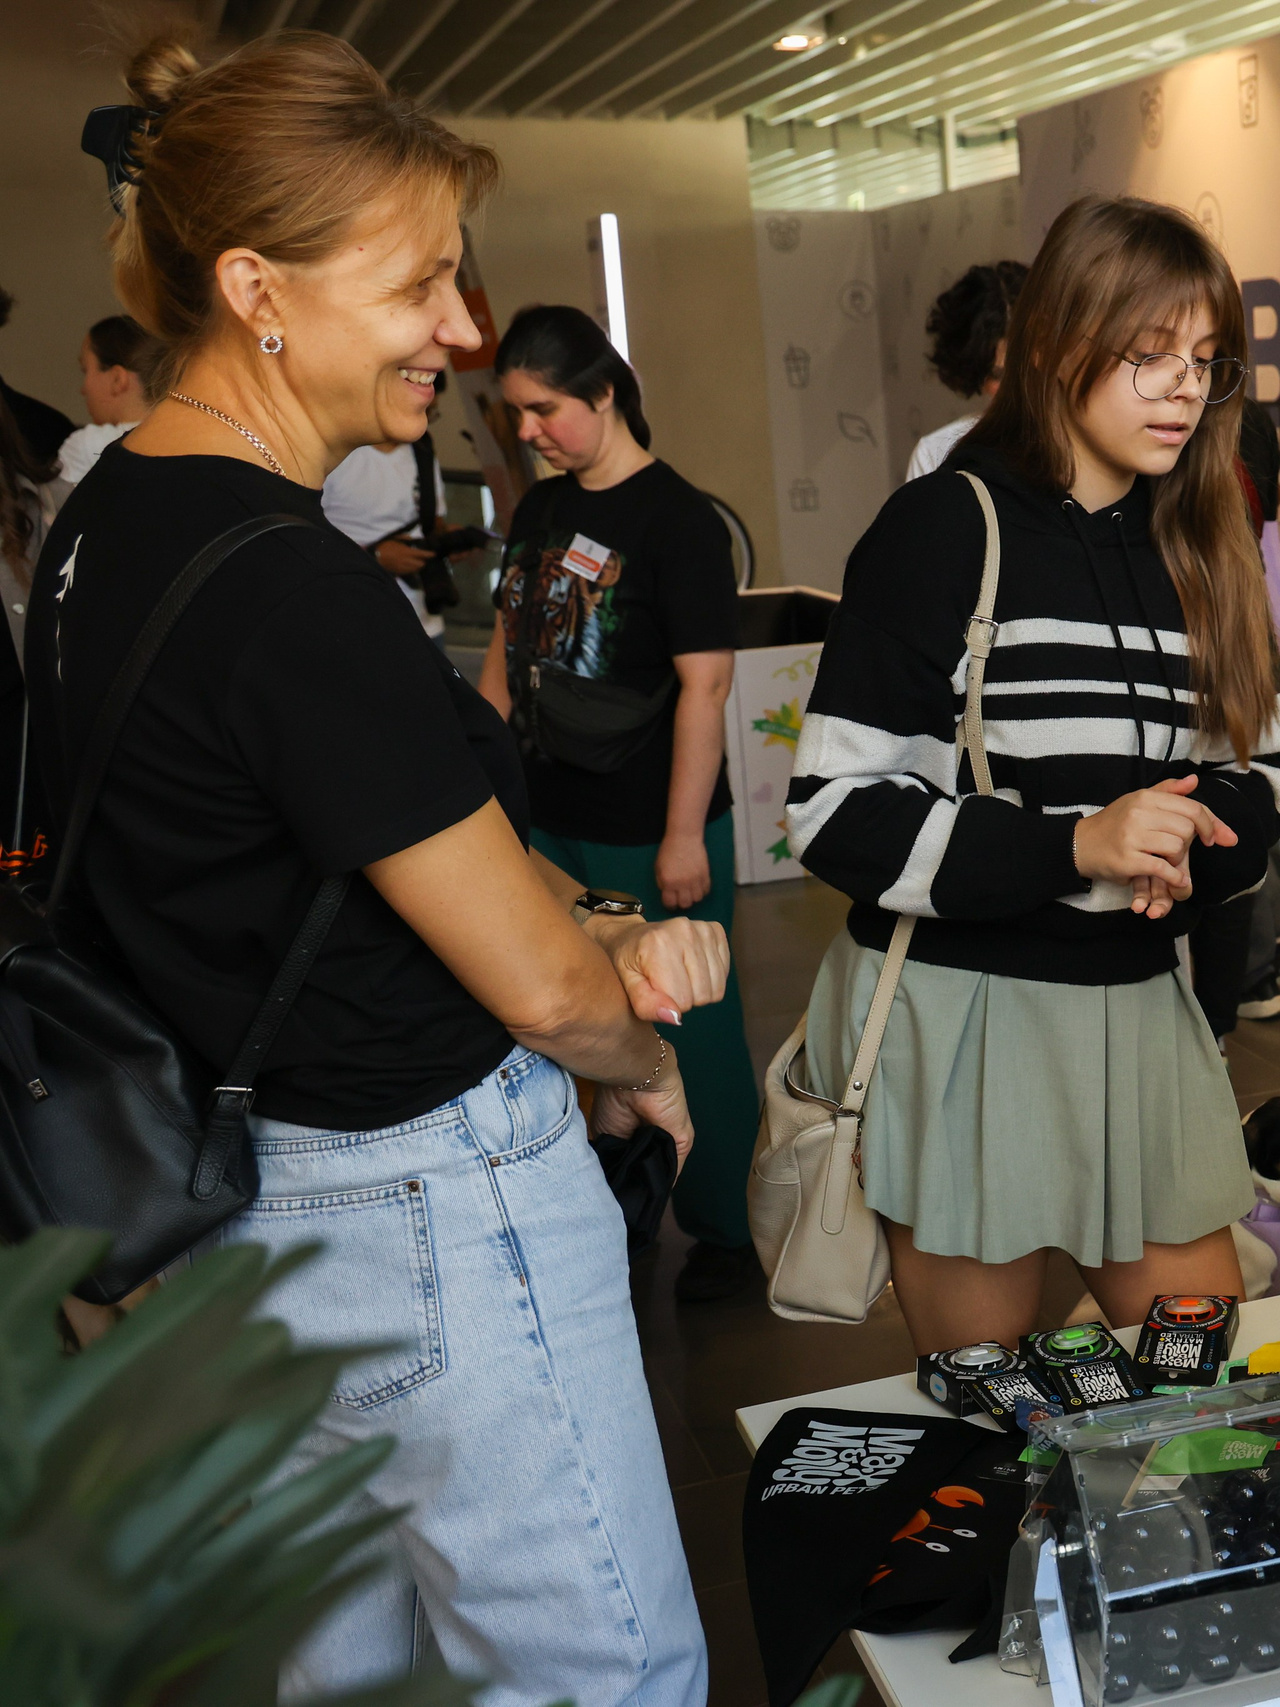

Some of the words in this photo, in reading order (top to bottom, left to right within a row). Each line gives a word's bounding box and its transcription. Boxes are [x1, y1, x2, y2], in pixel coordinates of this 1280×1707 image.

[1163, 1343, 1202, 1358] Molly
[1160, 1355, 1199, 1369] Max
[1078, 1367, 1116, 1378] MATRIX
[993, 1377, 1028, 1389] MATRIX
[1083, 1372, 1122, 1391] Molly
[1088, 1386, 1130, 1402] Max
[772, 1420, 869, 1485] Molly
[832, 1427, 926, 1486] Max
[761, 1483, 829, 1501] URBAN
